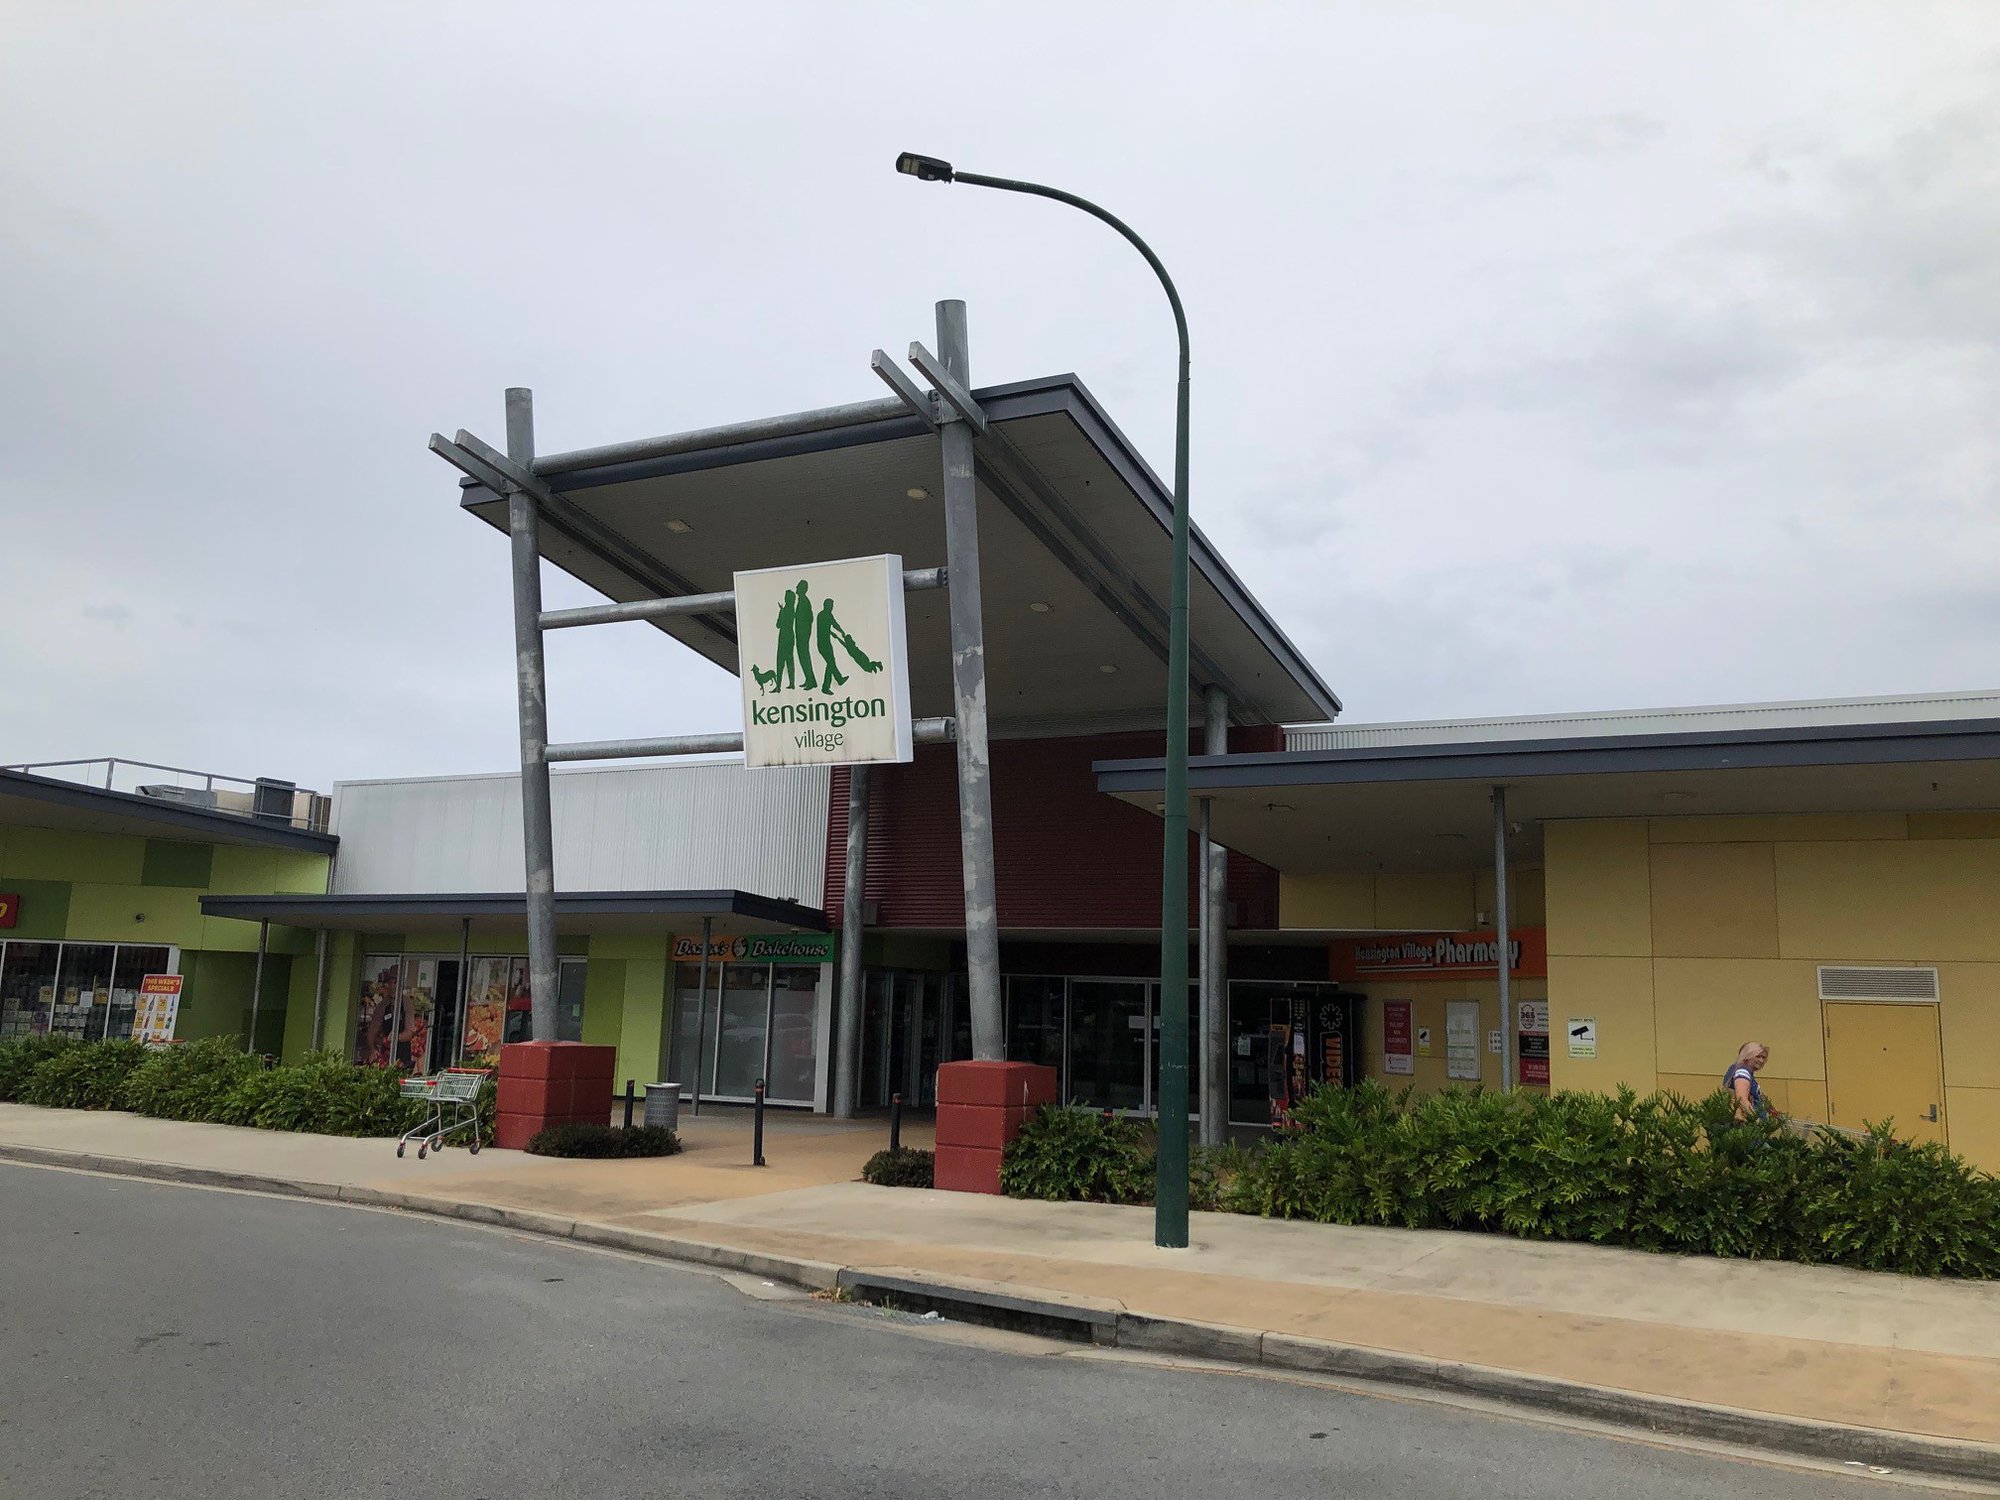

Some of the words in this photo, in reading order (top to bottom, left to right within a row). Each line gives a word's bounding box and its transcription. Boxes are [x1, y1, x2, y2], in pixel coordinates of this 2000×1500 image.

[752, 696, 885, 728] kensington
[795, 729, 844, 752] village
[752, 939, 829, 957] Bakehouse
[1355, 944, 1400, 963] Kensington
[1402, 942, 1433, 962] Village
[1435, 938, 1518, 968] Pharmay
[1521, 1011, 1535, 1019] 365
